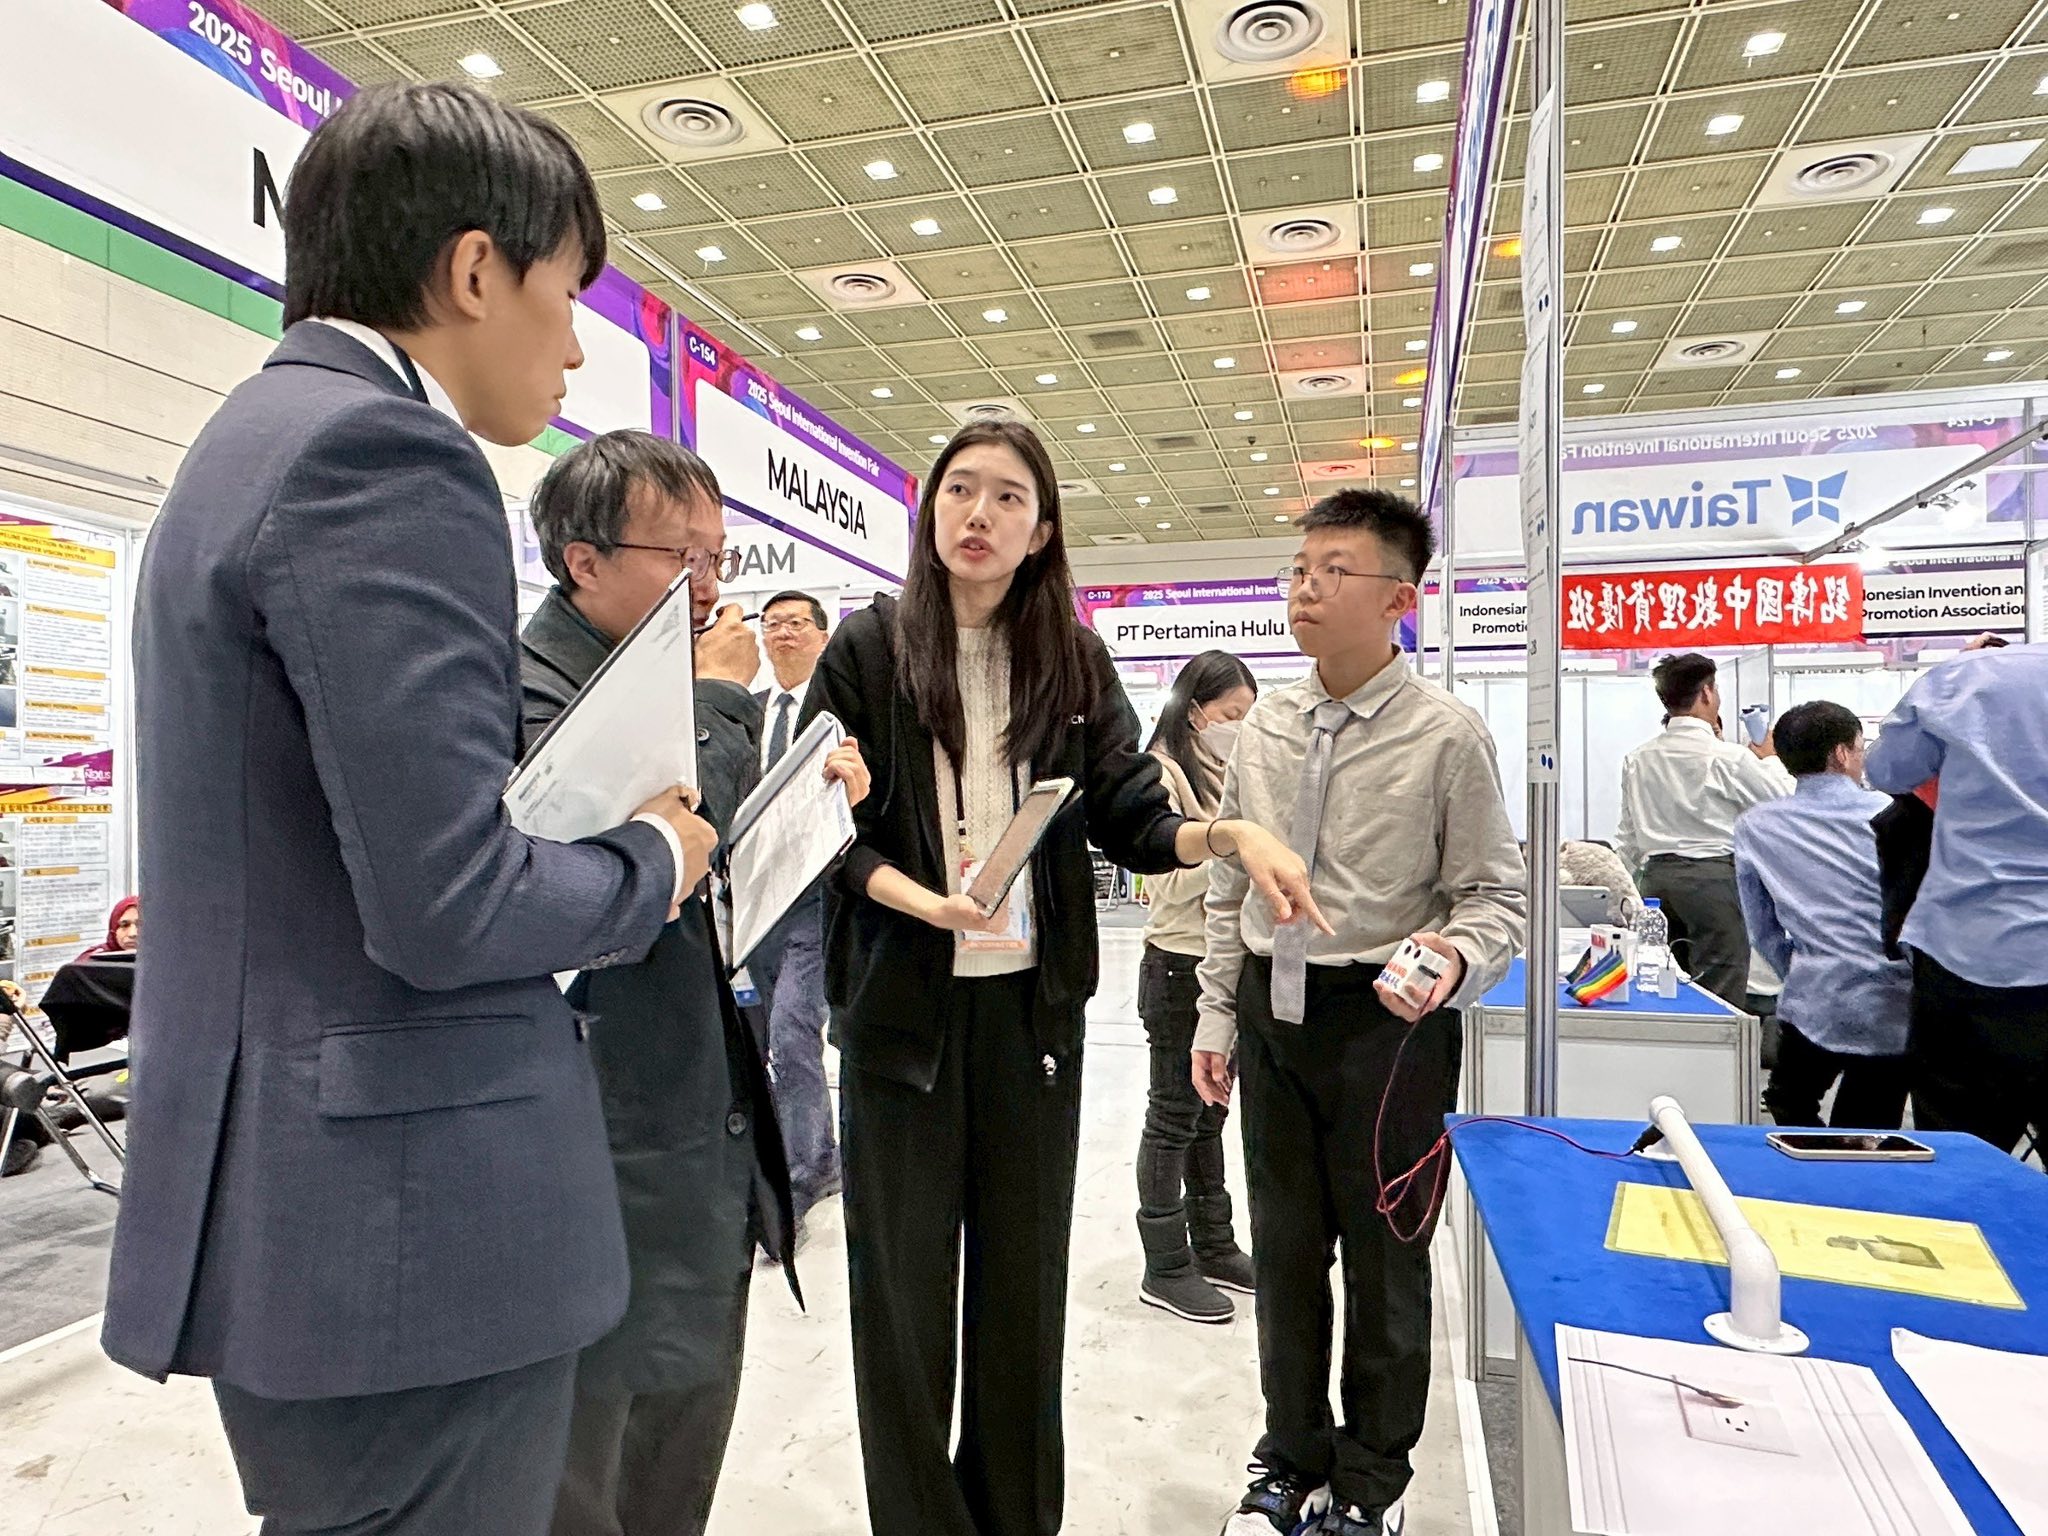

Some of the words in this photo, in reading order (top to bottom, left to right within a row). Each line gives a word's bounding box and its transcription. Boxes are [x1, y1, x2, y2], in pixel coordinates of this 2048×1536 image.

[188, 1, 252, 66] 2025
[260, 47, 331, 119] Seoul
[689, 336, 716, 366] C-154
[747, 378, 768, 405] 2025
[768, 391, 791, 421] Seoul
[791, 406, 838, 451] International
[837, 437, 868, 471] Invention
[867, 457, 881, 477] Fair
[767, 447, 867, 539] MALAYSIA
[1088, 591, 1111, 600] C-173
[1143, 590, 1164, 600] 2025
[1165, 588, 1192, 599] Seoul
[1193, 585, 1254, 598] International
[1929, 583, 2001, 598] Invention
[2004, 585, 2024, 595] an
[1117, 625, 1139, 641] PT
[1143, 620, 1237, 640] Pertamina
[1241, 619, 1285, 637] Hulu
